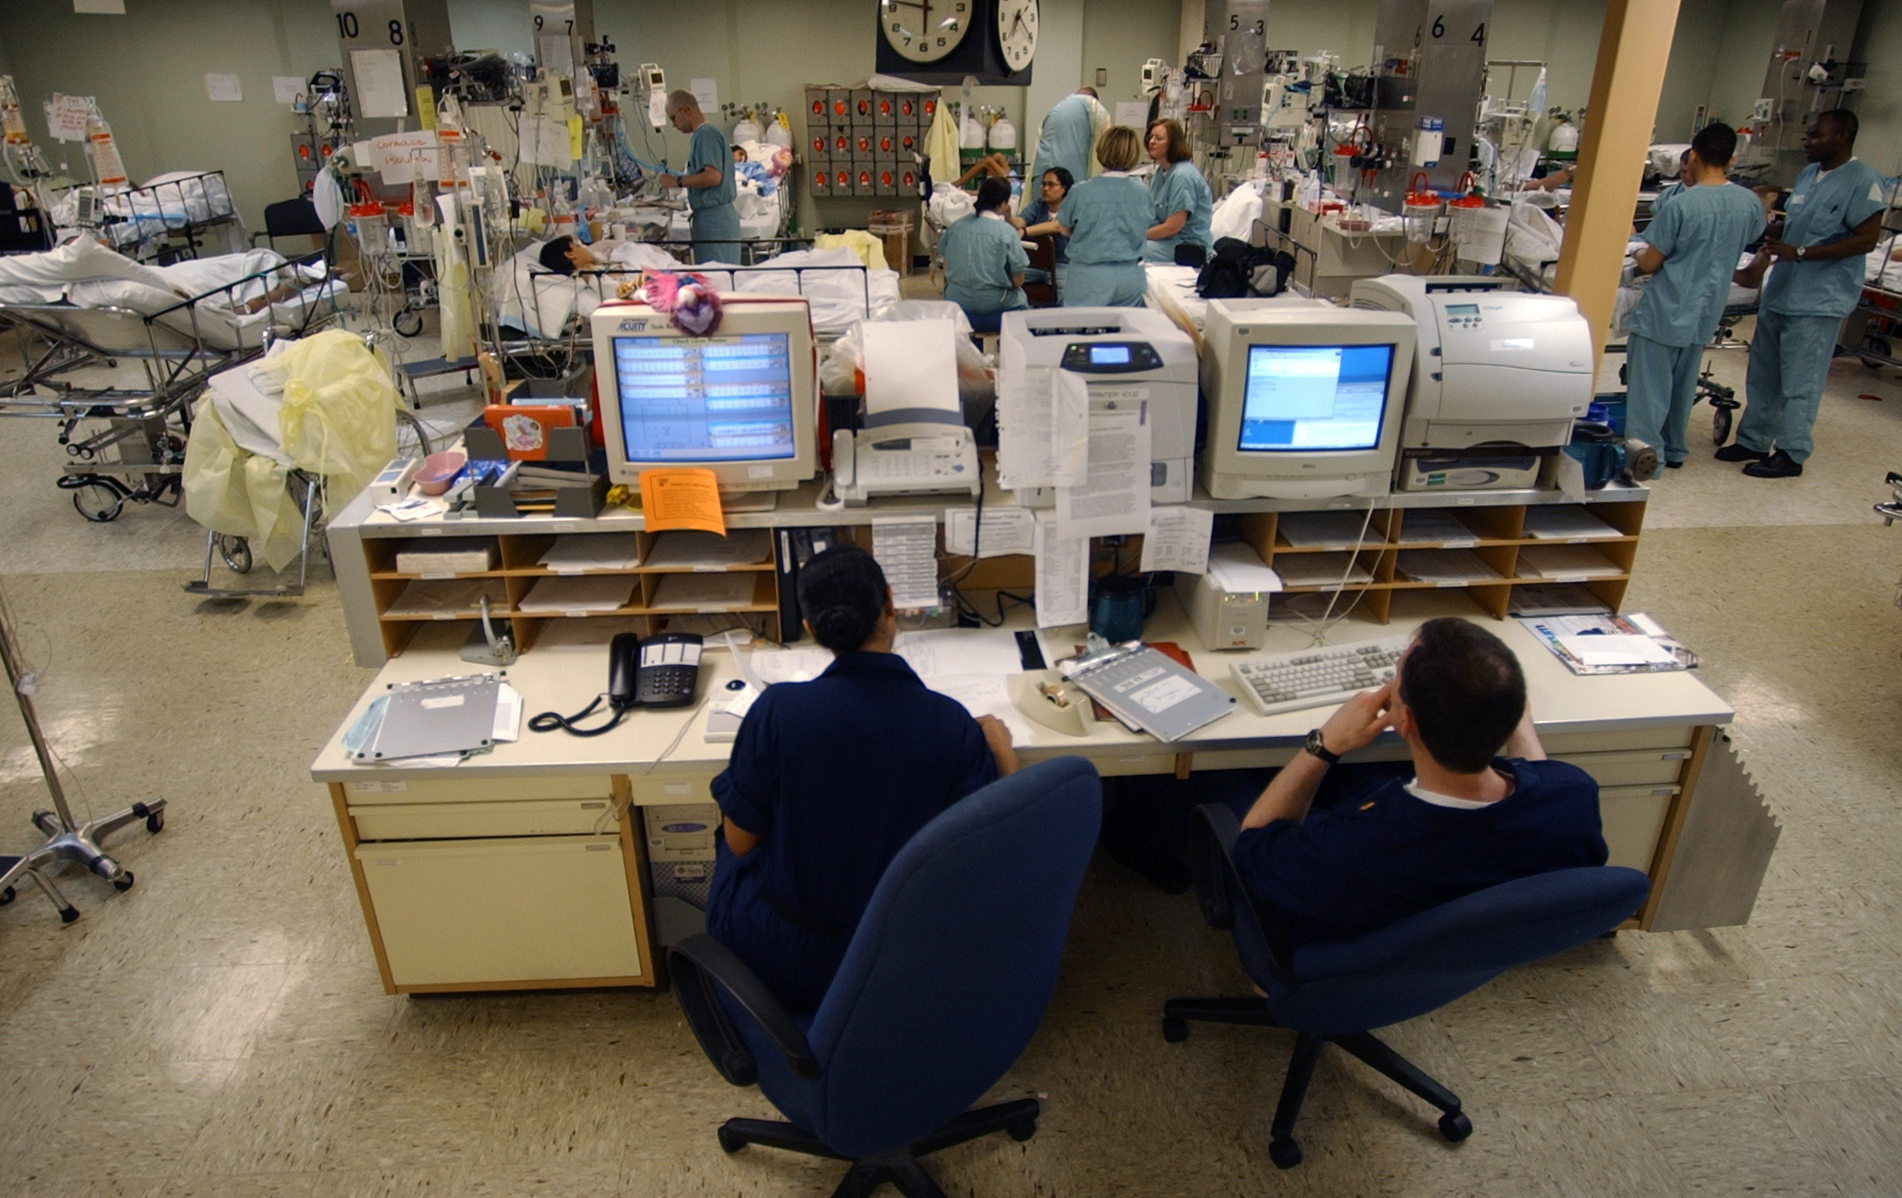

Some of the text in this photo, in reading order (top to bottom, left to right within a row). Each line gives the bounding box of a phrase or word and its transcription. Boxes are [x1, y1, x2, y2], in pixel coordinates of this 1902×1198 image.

[888, 4, 897, 12] 9
[956, 3, 965, 12] 3
[336, 11, 359, 39] 10
[534, 15, 544, 31] 9
[564, 20, 574, 36] 7
[892, 24, 900, 32] 8
[949, 23, 958, 32] 4
[1230, 14, 1239, 31] 5
[1255, 19, 1264, 36] 3
[1431, 14, 1445, 38] 6
[388, 19, 404, 46] 8
[1470, 22, 1485, 47] 4
[903, 37, 911, 46] 7
[919, 43, 928, 52] 6
[936, 37, 946, 46] 5
